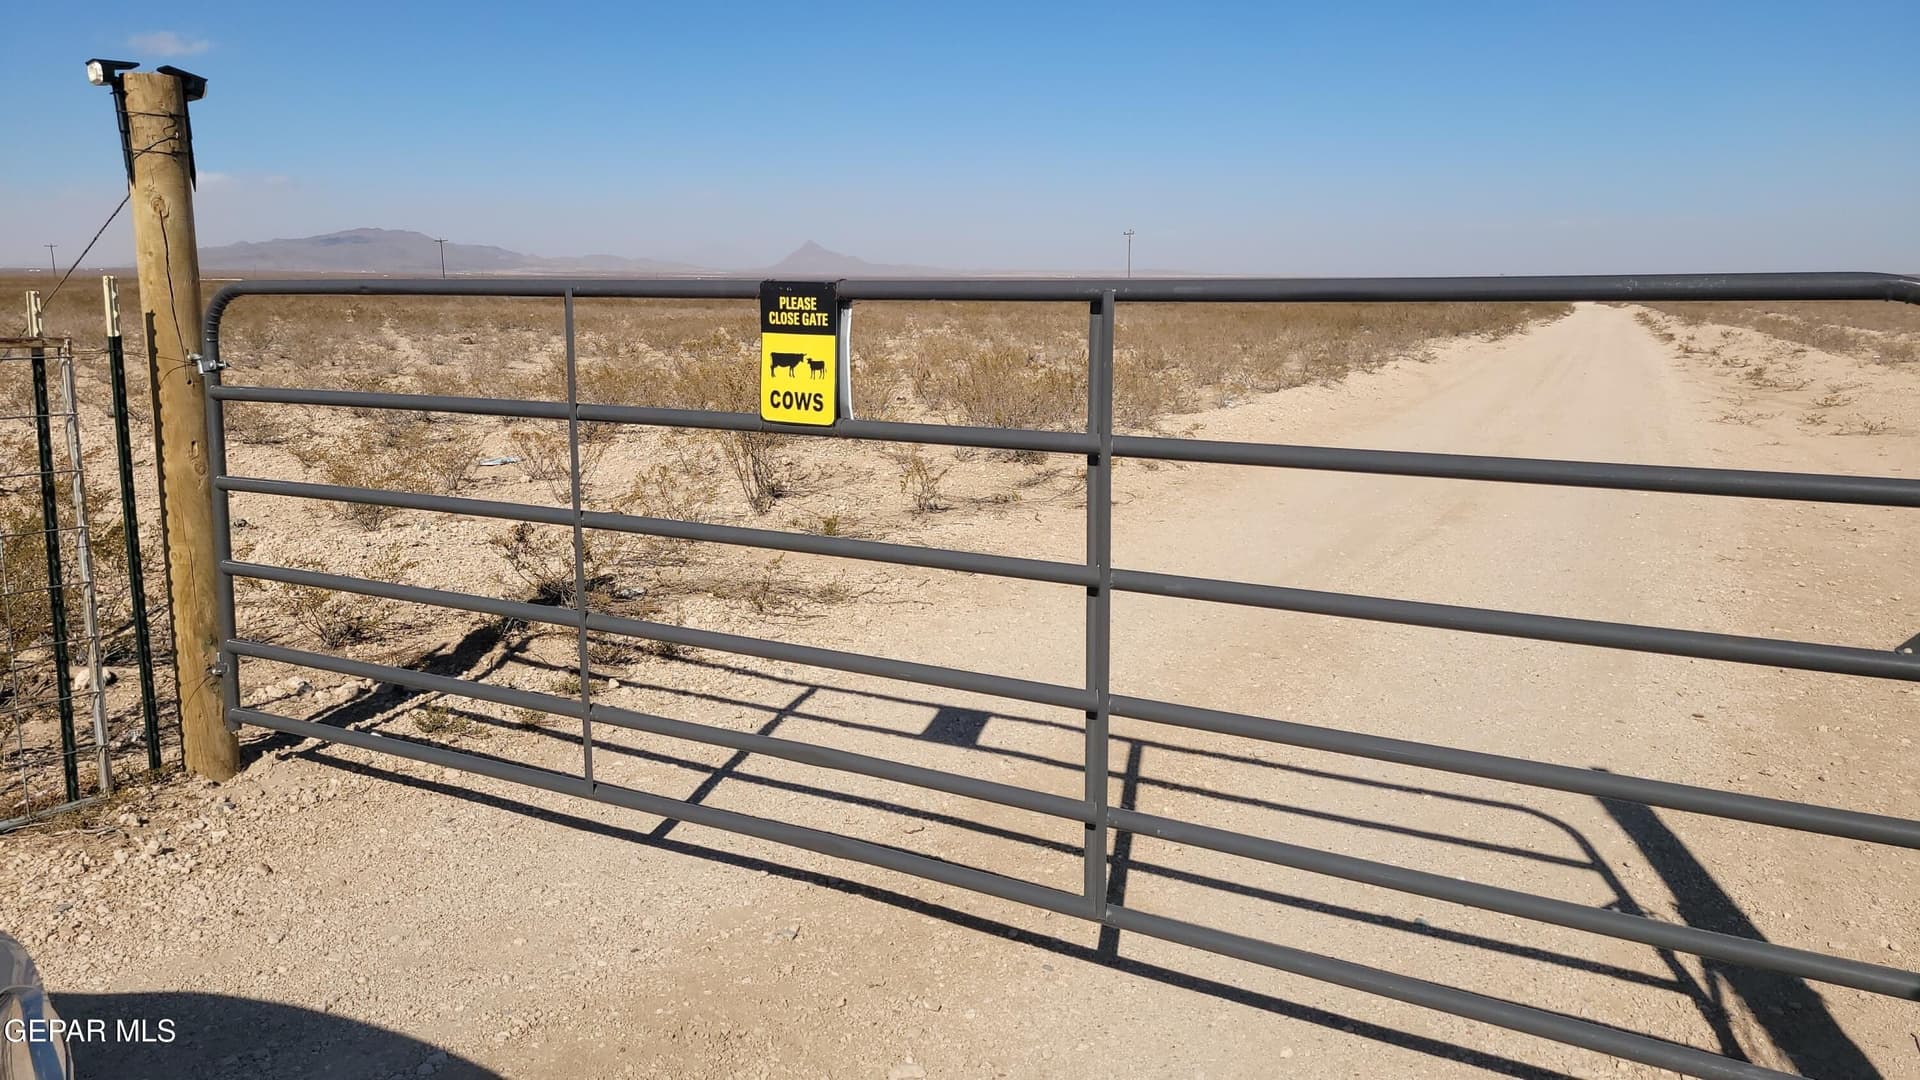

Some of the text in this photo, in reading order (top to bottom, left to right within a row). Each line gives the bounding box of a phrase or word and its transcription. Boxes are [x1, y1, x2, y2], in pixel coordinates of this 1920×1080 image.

[779, 296, 817, 311] PLEASE
[769, 311, 828, 326] CLOSE GATE
[770, 390, 824, 412] COWS
